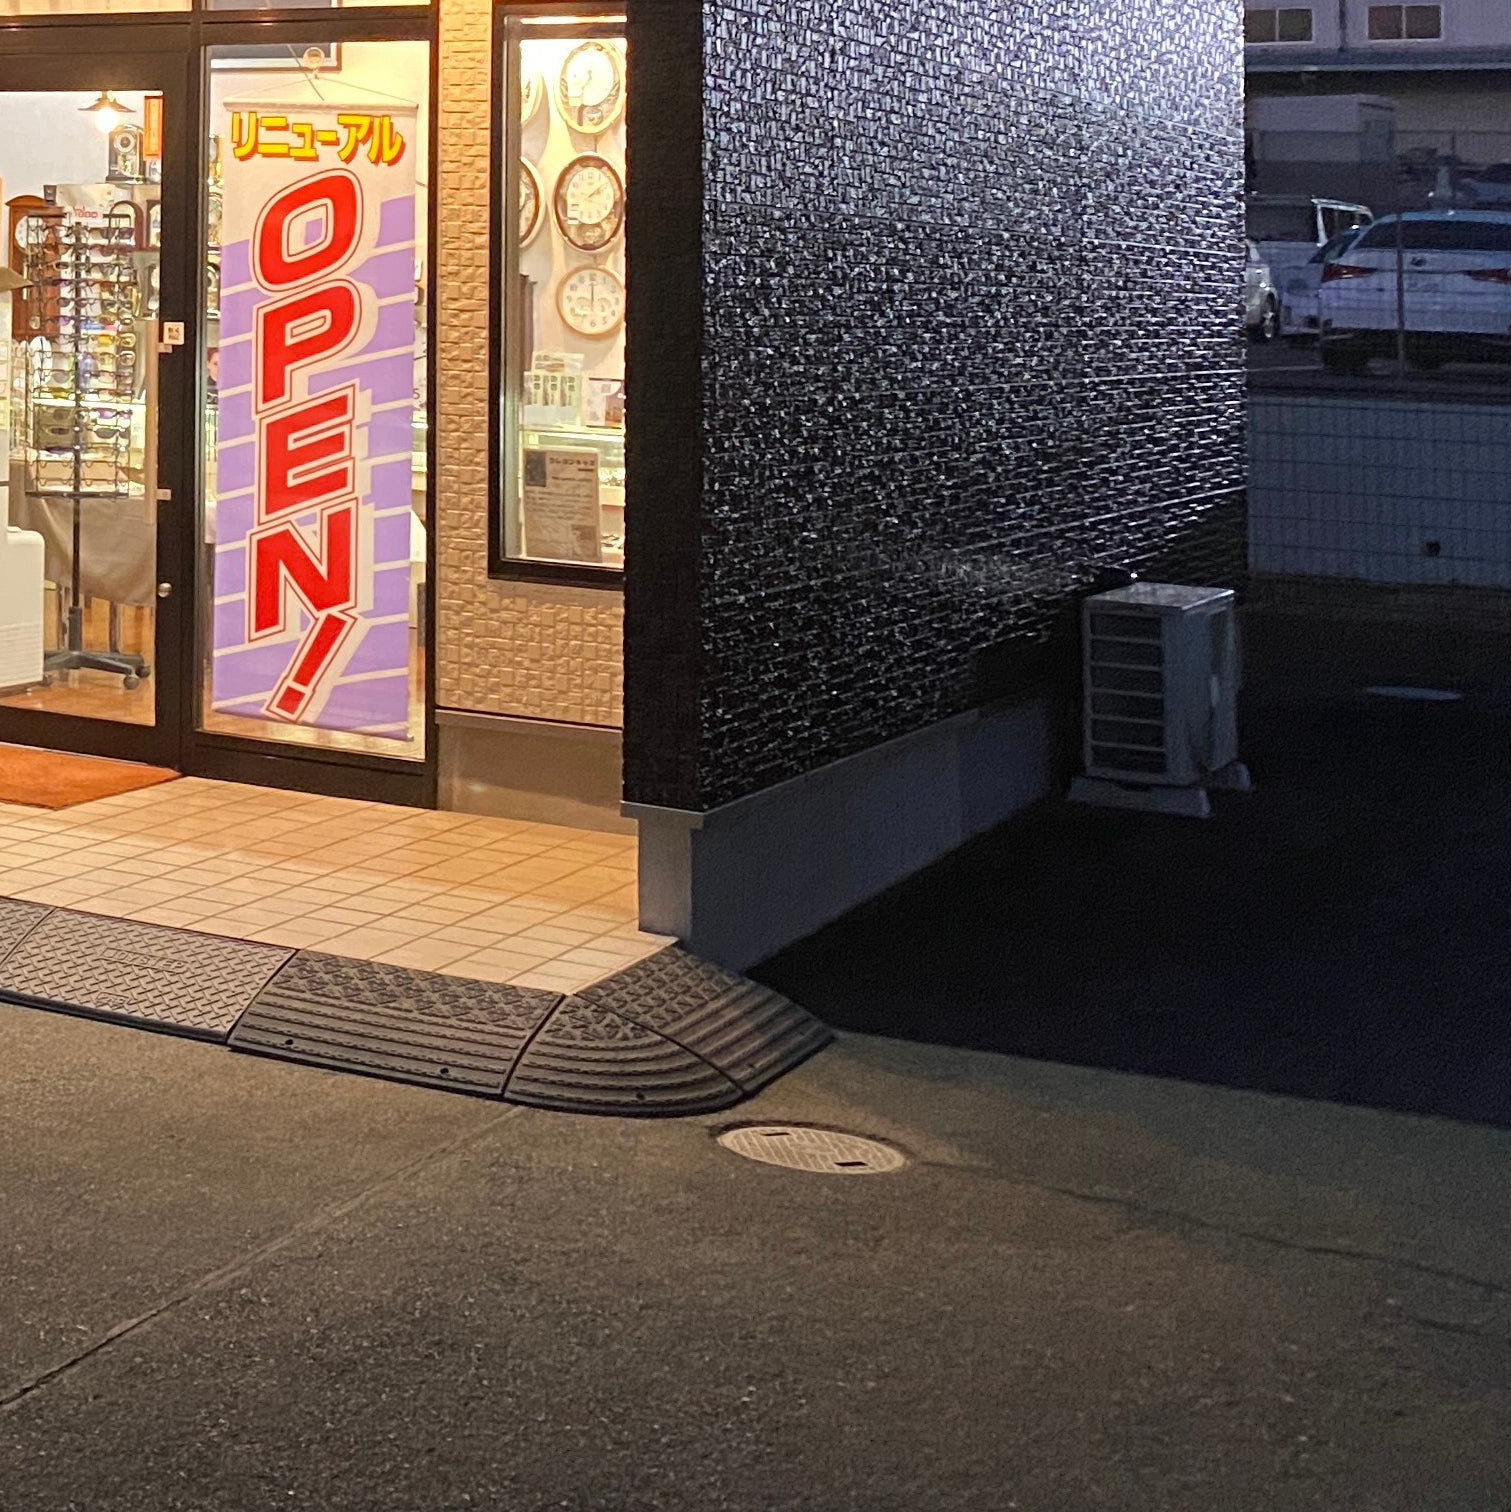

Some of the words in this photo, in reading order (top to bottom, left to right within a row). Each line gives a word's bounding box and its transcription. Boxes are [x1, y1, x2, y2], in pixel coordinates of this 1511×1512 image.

[231, 111, 406, 166] リニューアル
